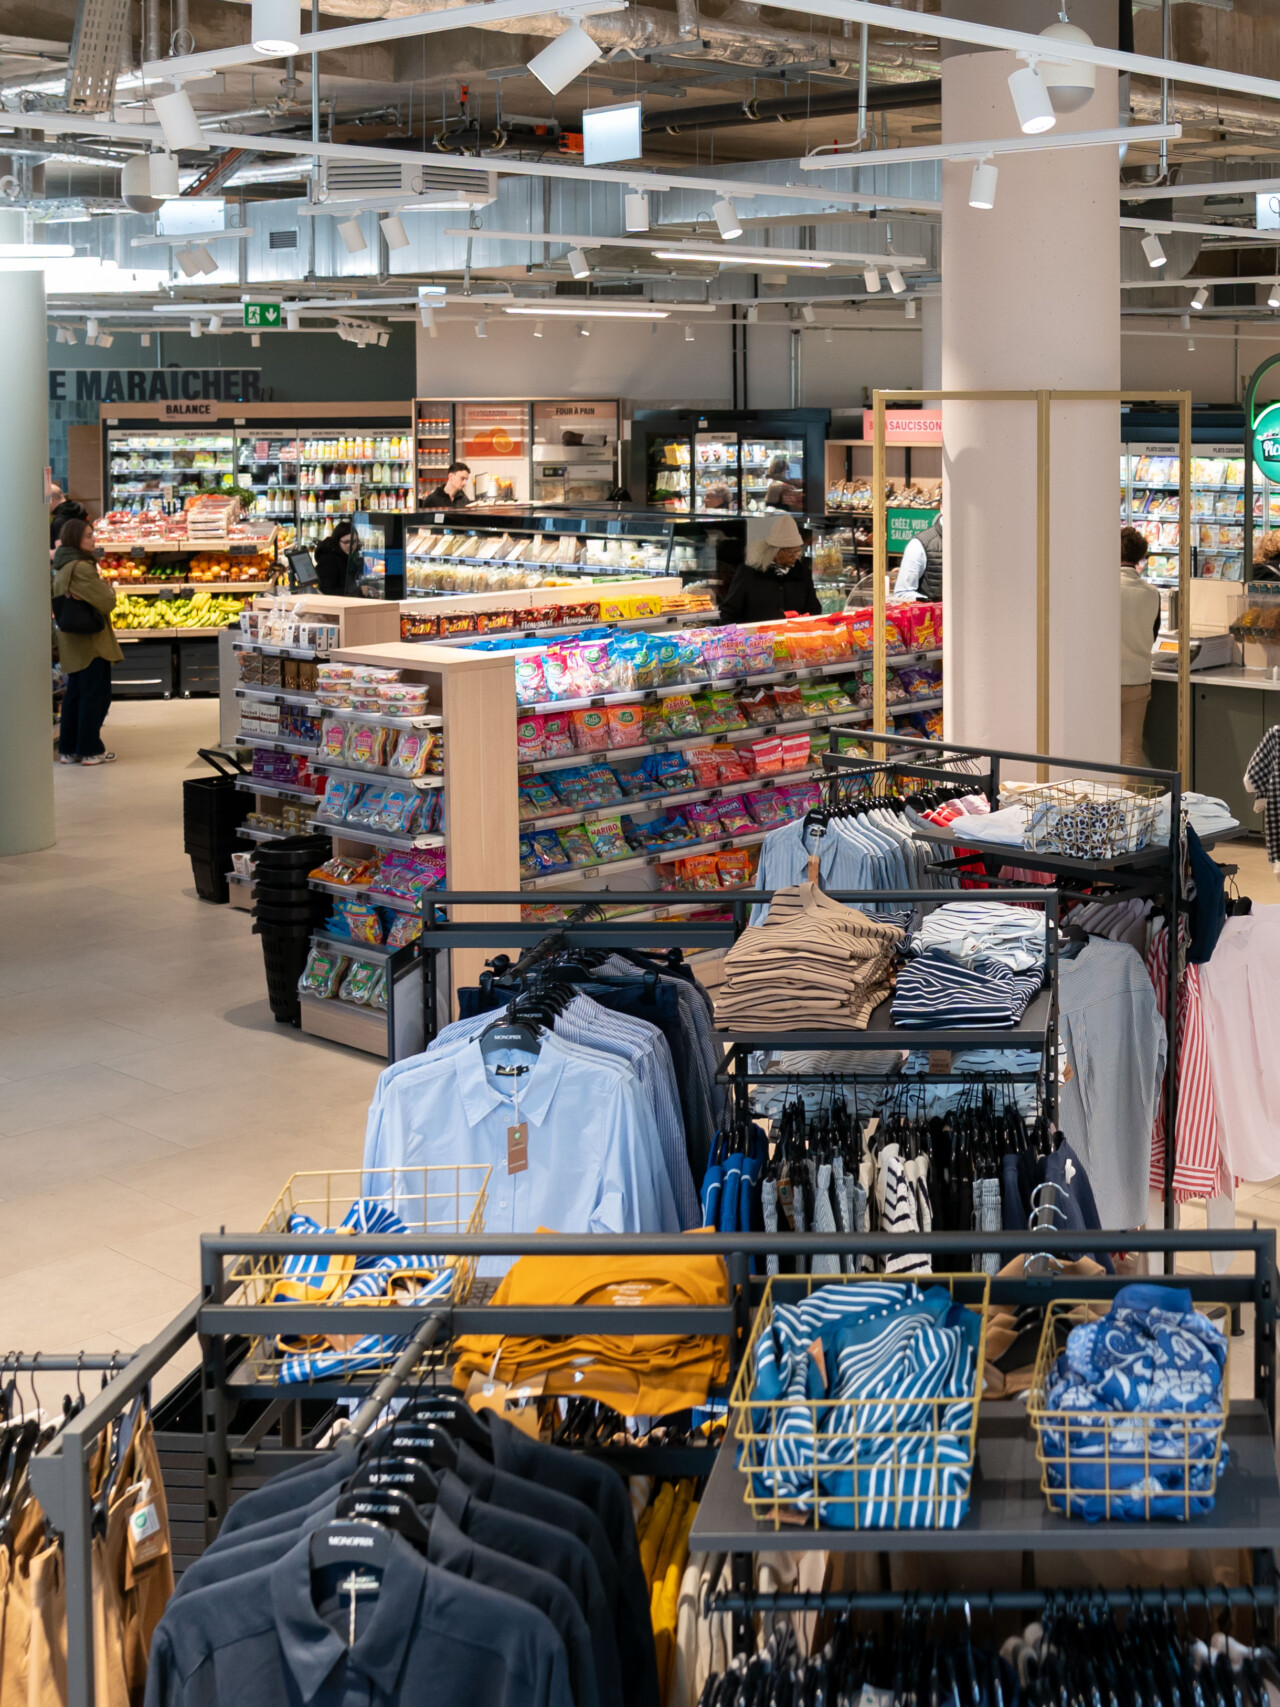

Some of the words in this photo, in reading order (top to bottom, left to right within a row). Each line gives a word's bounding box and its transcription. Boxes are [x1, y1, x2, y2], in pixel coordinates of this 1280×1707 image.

[166, 404, 211, 415] BALANCE
[556, 407, 573, 415] FOUR
[574, 406, 579, 415] À
[580, 407, 595, 415] PAIN
[889, 421, 942, 431] SAUCISSON
[891, 517, 910, 529] CRÉEZ
[718, 801, 740, 815] MAOAM
[590, 823, 618, 836] HARIBO
[354, 1502, 401, 1515] MONOPRIX
[328, 1535, 375, 1548] MONOPRIX
